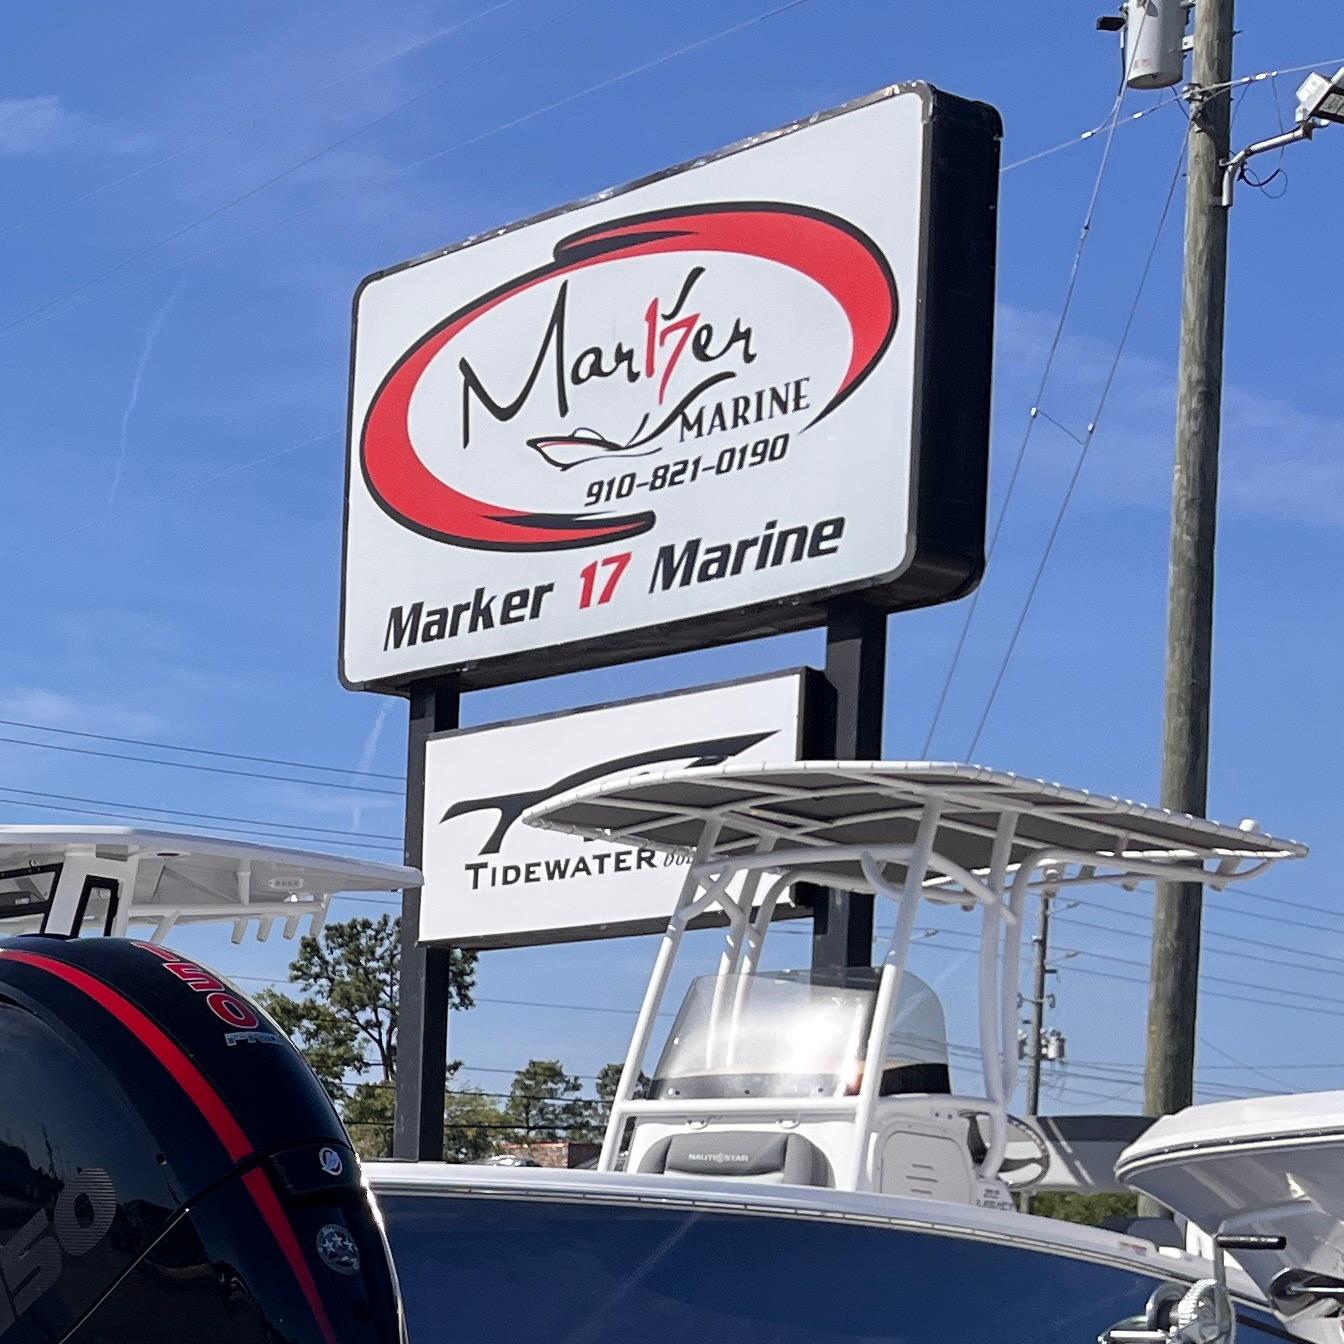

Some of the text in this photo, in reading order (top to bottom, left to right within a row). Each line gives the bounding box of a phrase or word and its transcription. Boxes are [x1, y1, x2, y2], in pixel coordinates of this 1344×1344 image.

[679, 376, 811, 443] MARINE
[583, 433, 790, 507] 910-821-0190
[383, 516, 846, 652] Marker 17 Marine
[464, 849, 658, 890] TIDEWATER
[130, 941, 260, 1029] 150
